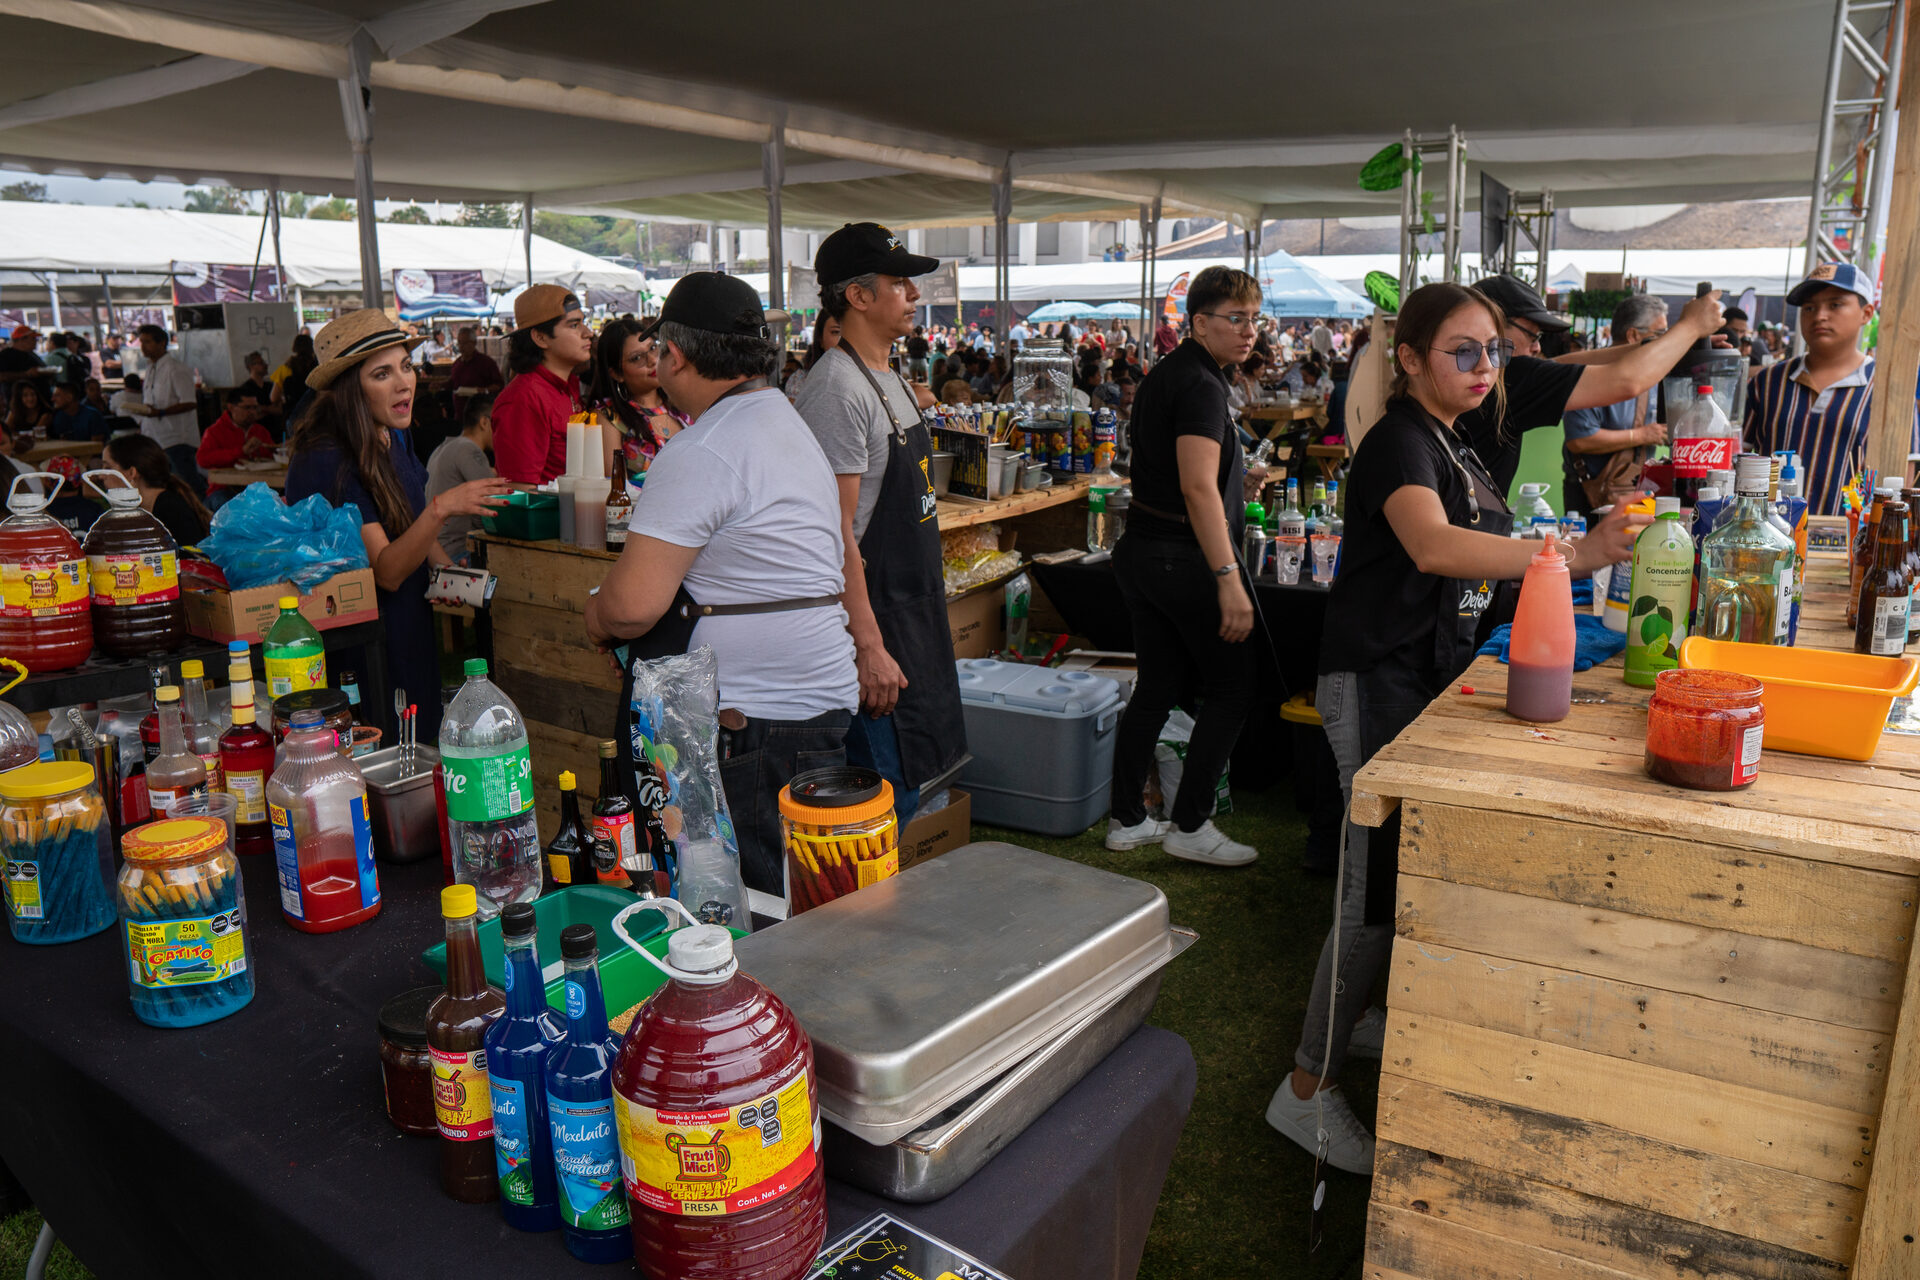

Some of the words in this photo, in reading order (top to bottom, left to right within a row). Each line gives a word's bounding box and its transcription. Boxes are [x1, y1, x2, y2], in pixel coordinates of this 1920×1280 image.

[1646, 566, 1691, 576] Concentrado
[182, 924, 195, 932] 50
[131, 948, 147, 964] EL
[148, 945, 214, 966] GATITO
[657, 1112, 683, 1121] Preparado
[684, 1113, 691, 1121] de
[707, 1110, 729, 1120] Natural
[683, 1149, 715, 1163] Fruti
[684, 1161, 716, 1174] Mich
[666, 1182, 689, 1192] DALE
[737, 1195, 760, 1207] Cont.
[761, 1189, 777, 1200] Net.
[778, 1183, 788, 1192] 5L
[684, 1202, 719, 1212] FRESA
